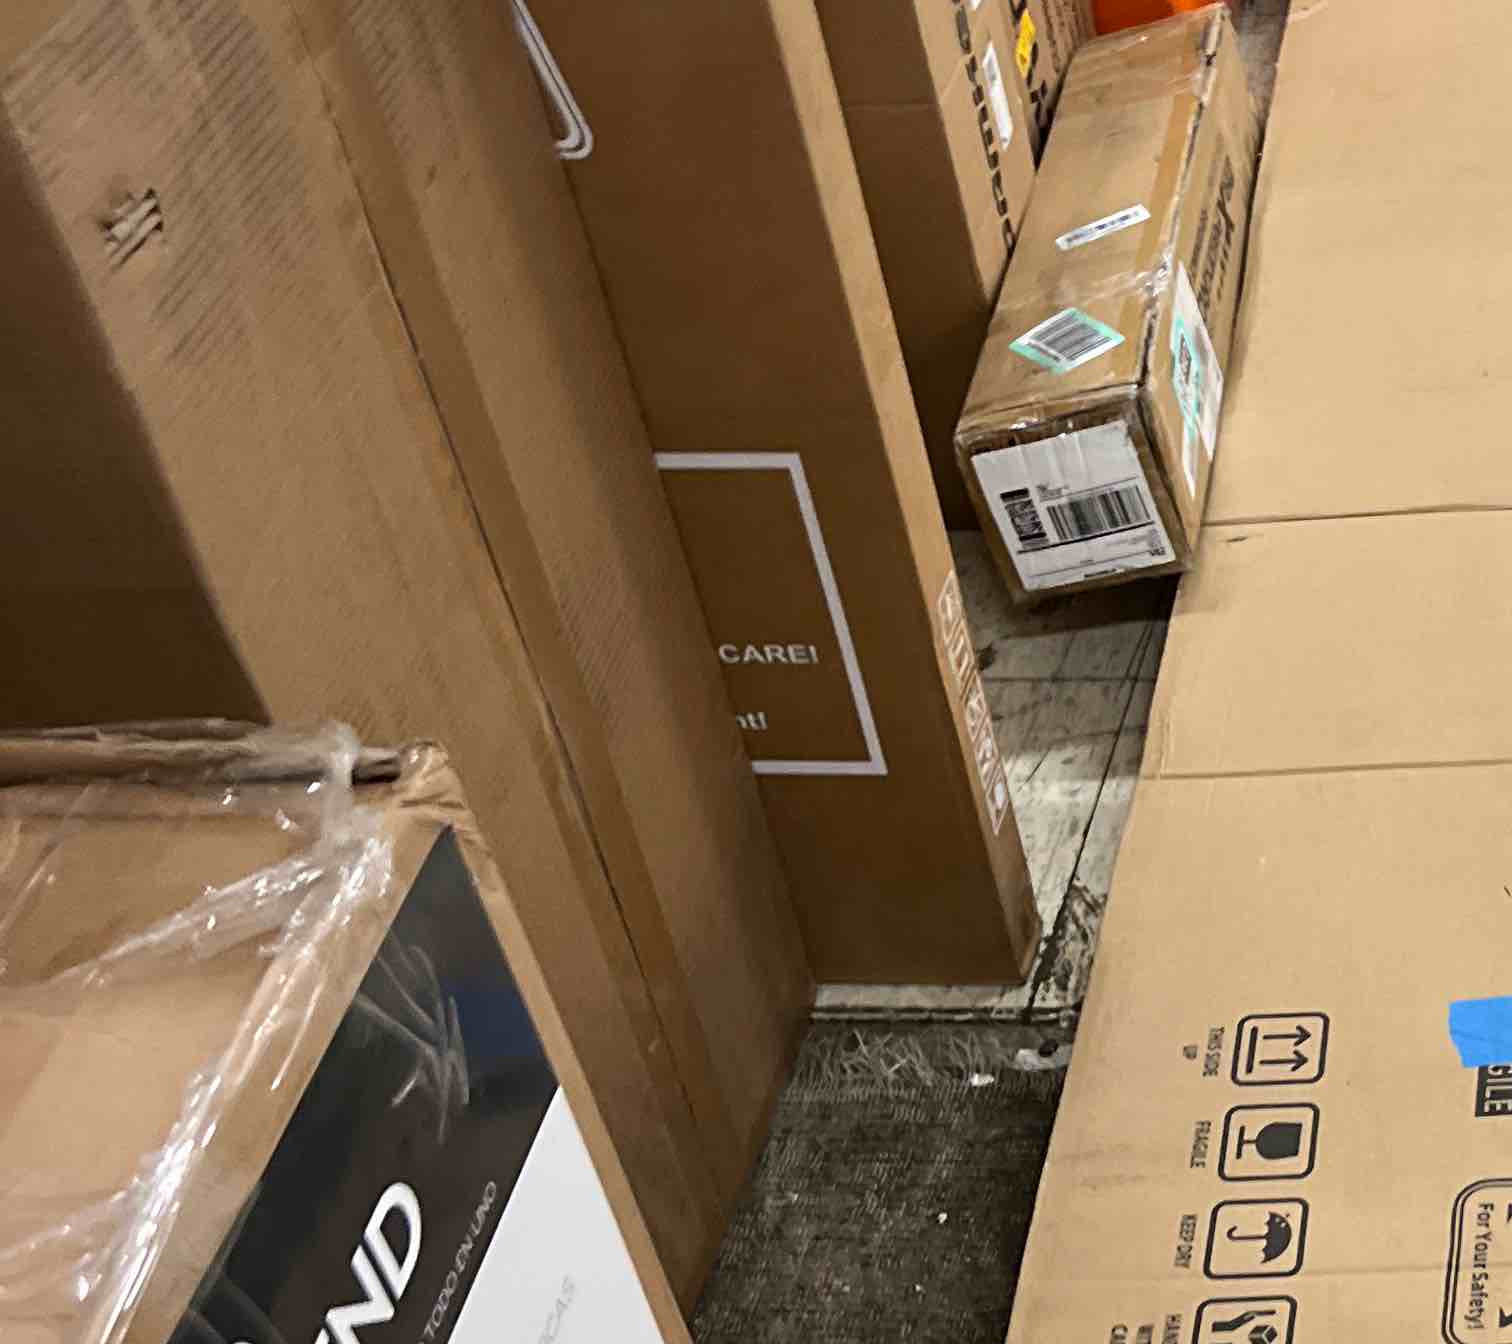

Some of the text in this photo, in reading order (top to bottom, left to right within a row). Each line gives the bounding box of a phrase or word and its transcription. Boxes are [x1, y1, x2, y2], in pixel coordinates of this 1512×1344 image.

[718, 643, 819, 665] CARE!
[1190, 1120, 1212, 1168] FRAGILE
[1178, 1214, 1198, 1242] KEEP
[1463, 1202, 1495, 1331] For Your Safety!
